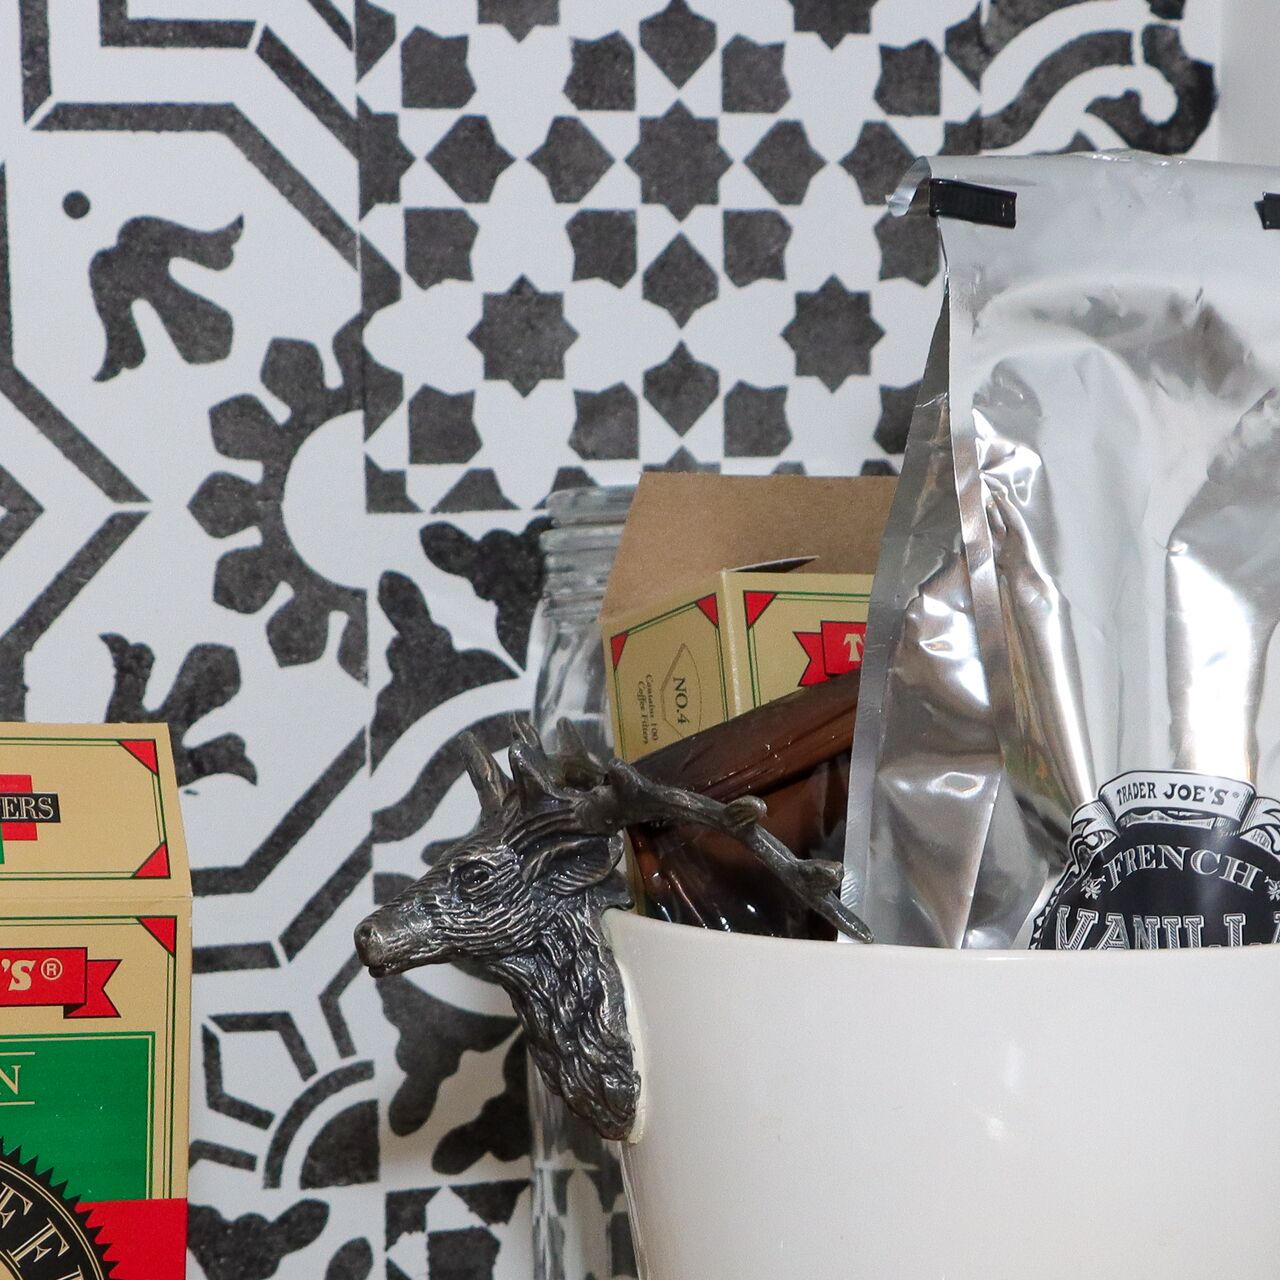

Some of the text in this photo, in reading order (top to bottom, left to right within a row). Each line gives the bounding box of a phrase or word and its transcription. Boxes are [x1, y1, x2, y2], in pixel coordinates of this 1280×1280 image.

[673, 677, 690, 725] NO.4
[1116, 782, 1157, 806] TRADER
[1102, 844, 1264, 892] FRENCH
